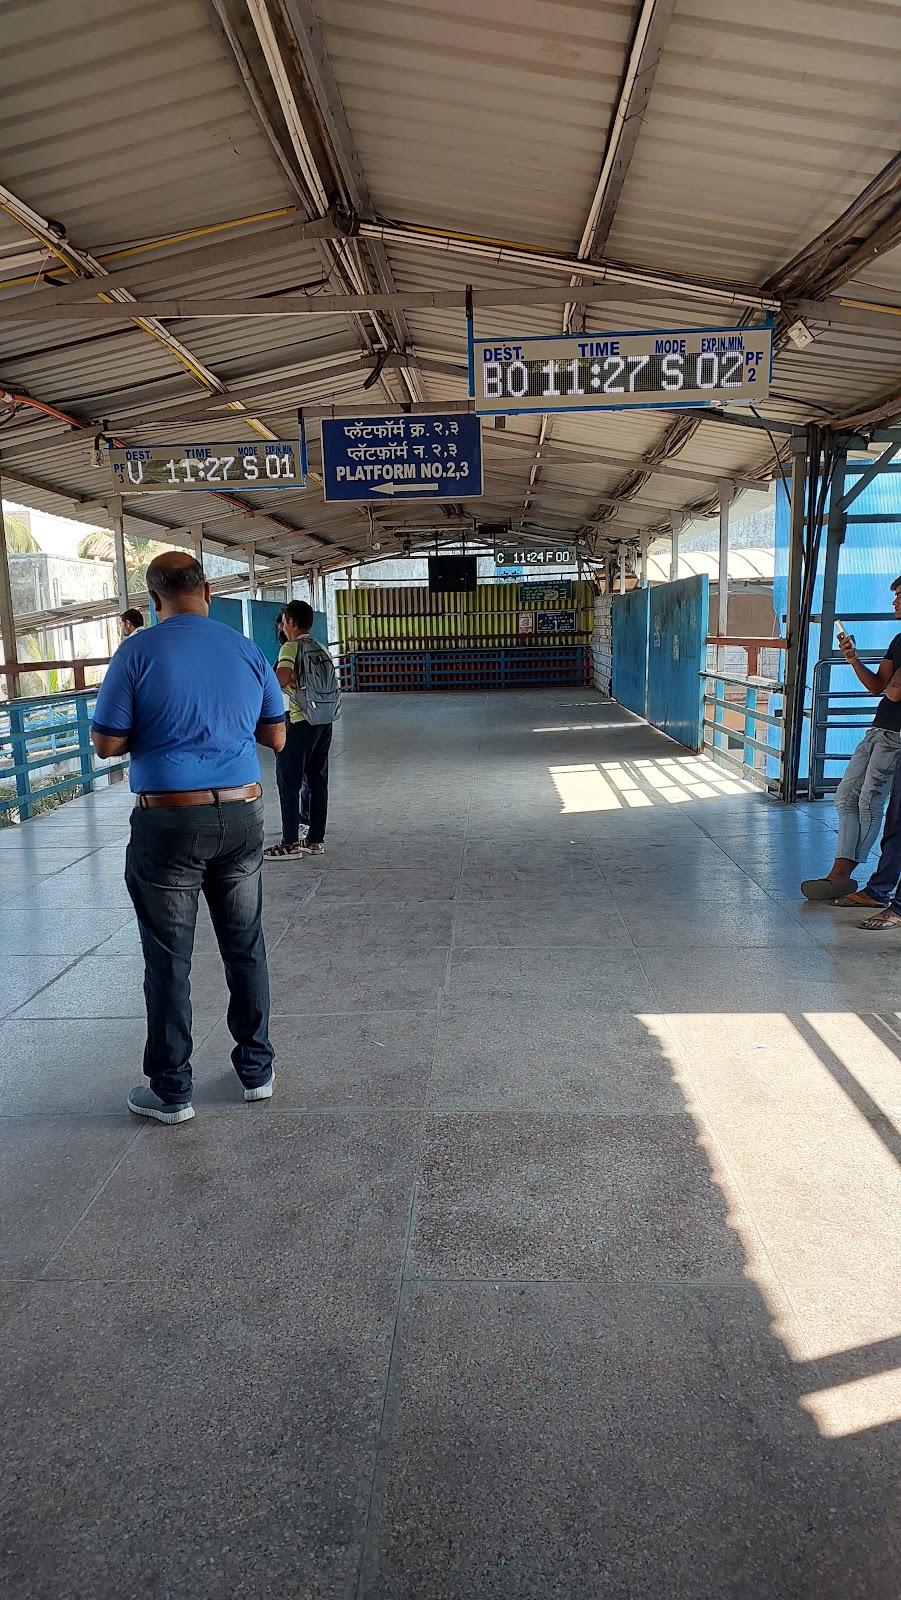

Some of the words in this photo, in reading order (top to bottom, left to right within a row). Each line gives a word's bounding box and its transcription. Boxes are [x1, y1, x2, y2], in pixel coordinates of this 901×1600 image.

[484, 346, 525, 361] DEST.
[578, 341, 620, 357] TIME
[655, 339, 686, 354] MODE
[746, 351, 764, 365] PF
[543, 355, 650, 396] 11:27
[661, 354, 684, 391] S
[696, 351, 744, 389] 02
[747, 368, 757, 382] 2
[409, 423, 430, 438] क्र.
[433, 421, 459, 436] २,३
[125, 450, 153, 461] DEST.
[184, 448, 212, 459] TIME
[237, 446, 258, 457] MODE
[412, 445, 428, 458] न.
[431, 443, 457, 458] २,३
[114, 463, 125, 473] PF
[166, 456, 235, 483] 11:27
[242, 455, 258, 480] S
[265, 453, 294, 479] 01
[336, 463, 416, 481] PLATFORM
[420, 461, 469, 480] NO.2,3
[118, 474, 125, 484] 3
[497, 552, 504, 564] C
[513, 551, 544, 563] 11:24
[546, 551, 553, 563] F
[555, 551, 569, 562] 00
